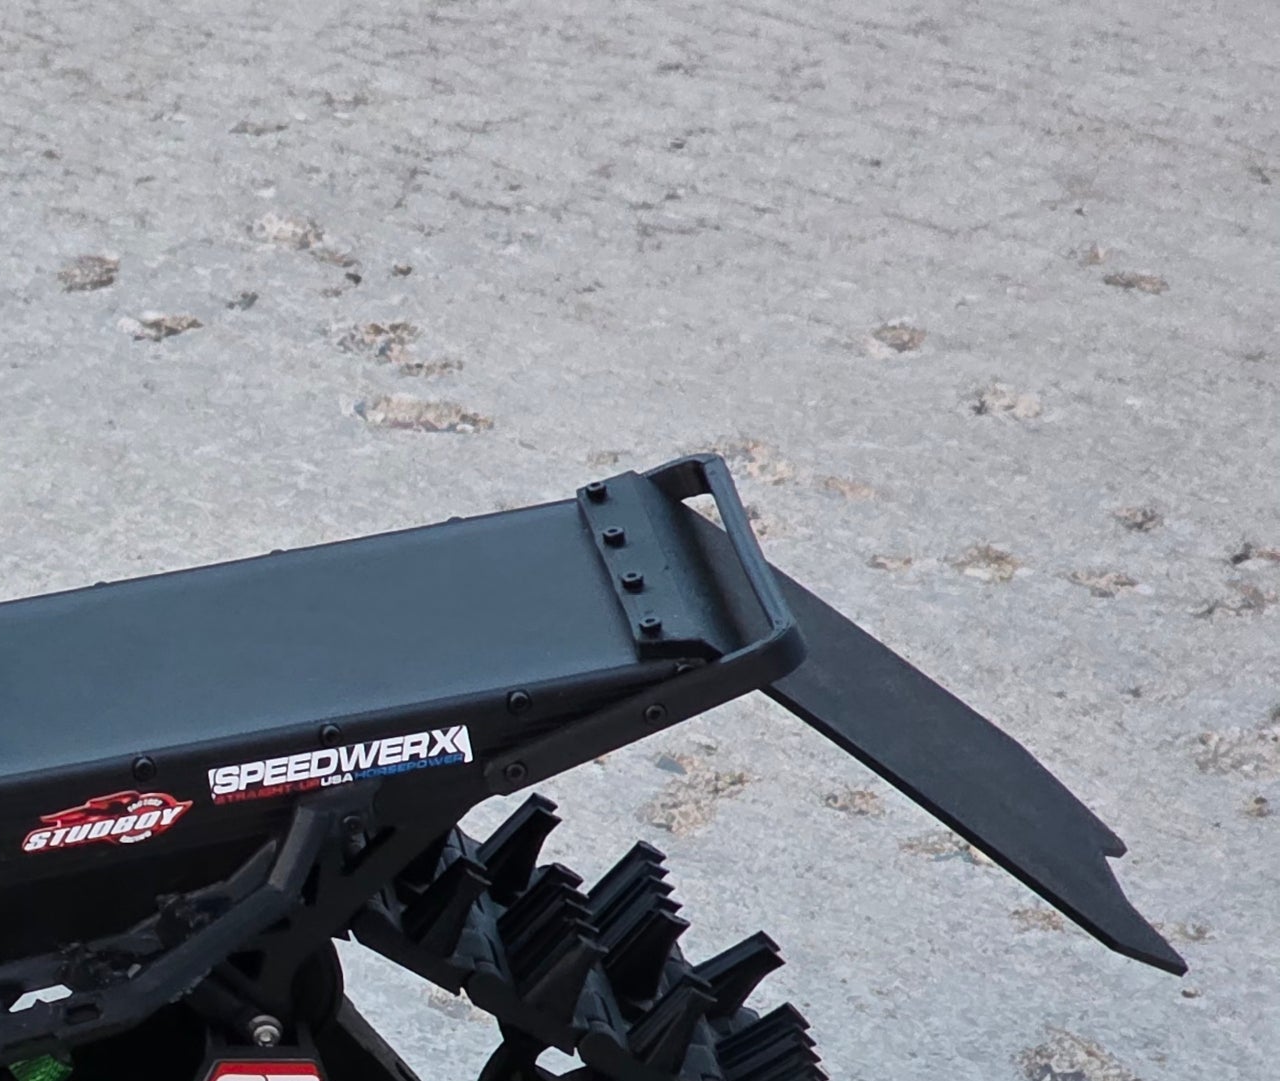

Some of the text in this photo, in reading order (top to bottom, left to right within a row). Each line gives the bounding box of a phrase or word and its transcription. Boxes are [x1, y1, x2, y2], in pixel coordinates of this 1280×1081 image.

[214, 726, 461, 794] SPEEDWERX
[321, 772, 353, 787] USA
[355, 753, 463, 780] HORSEPOWER
[24, 806, 183, 851] STUDBOY
